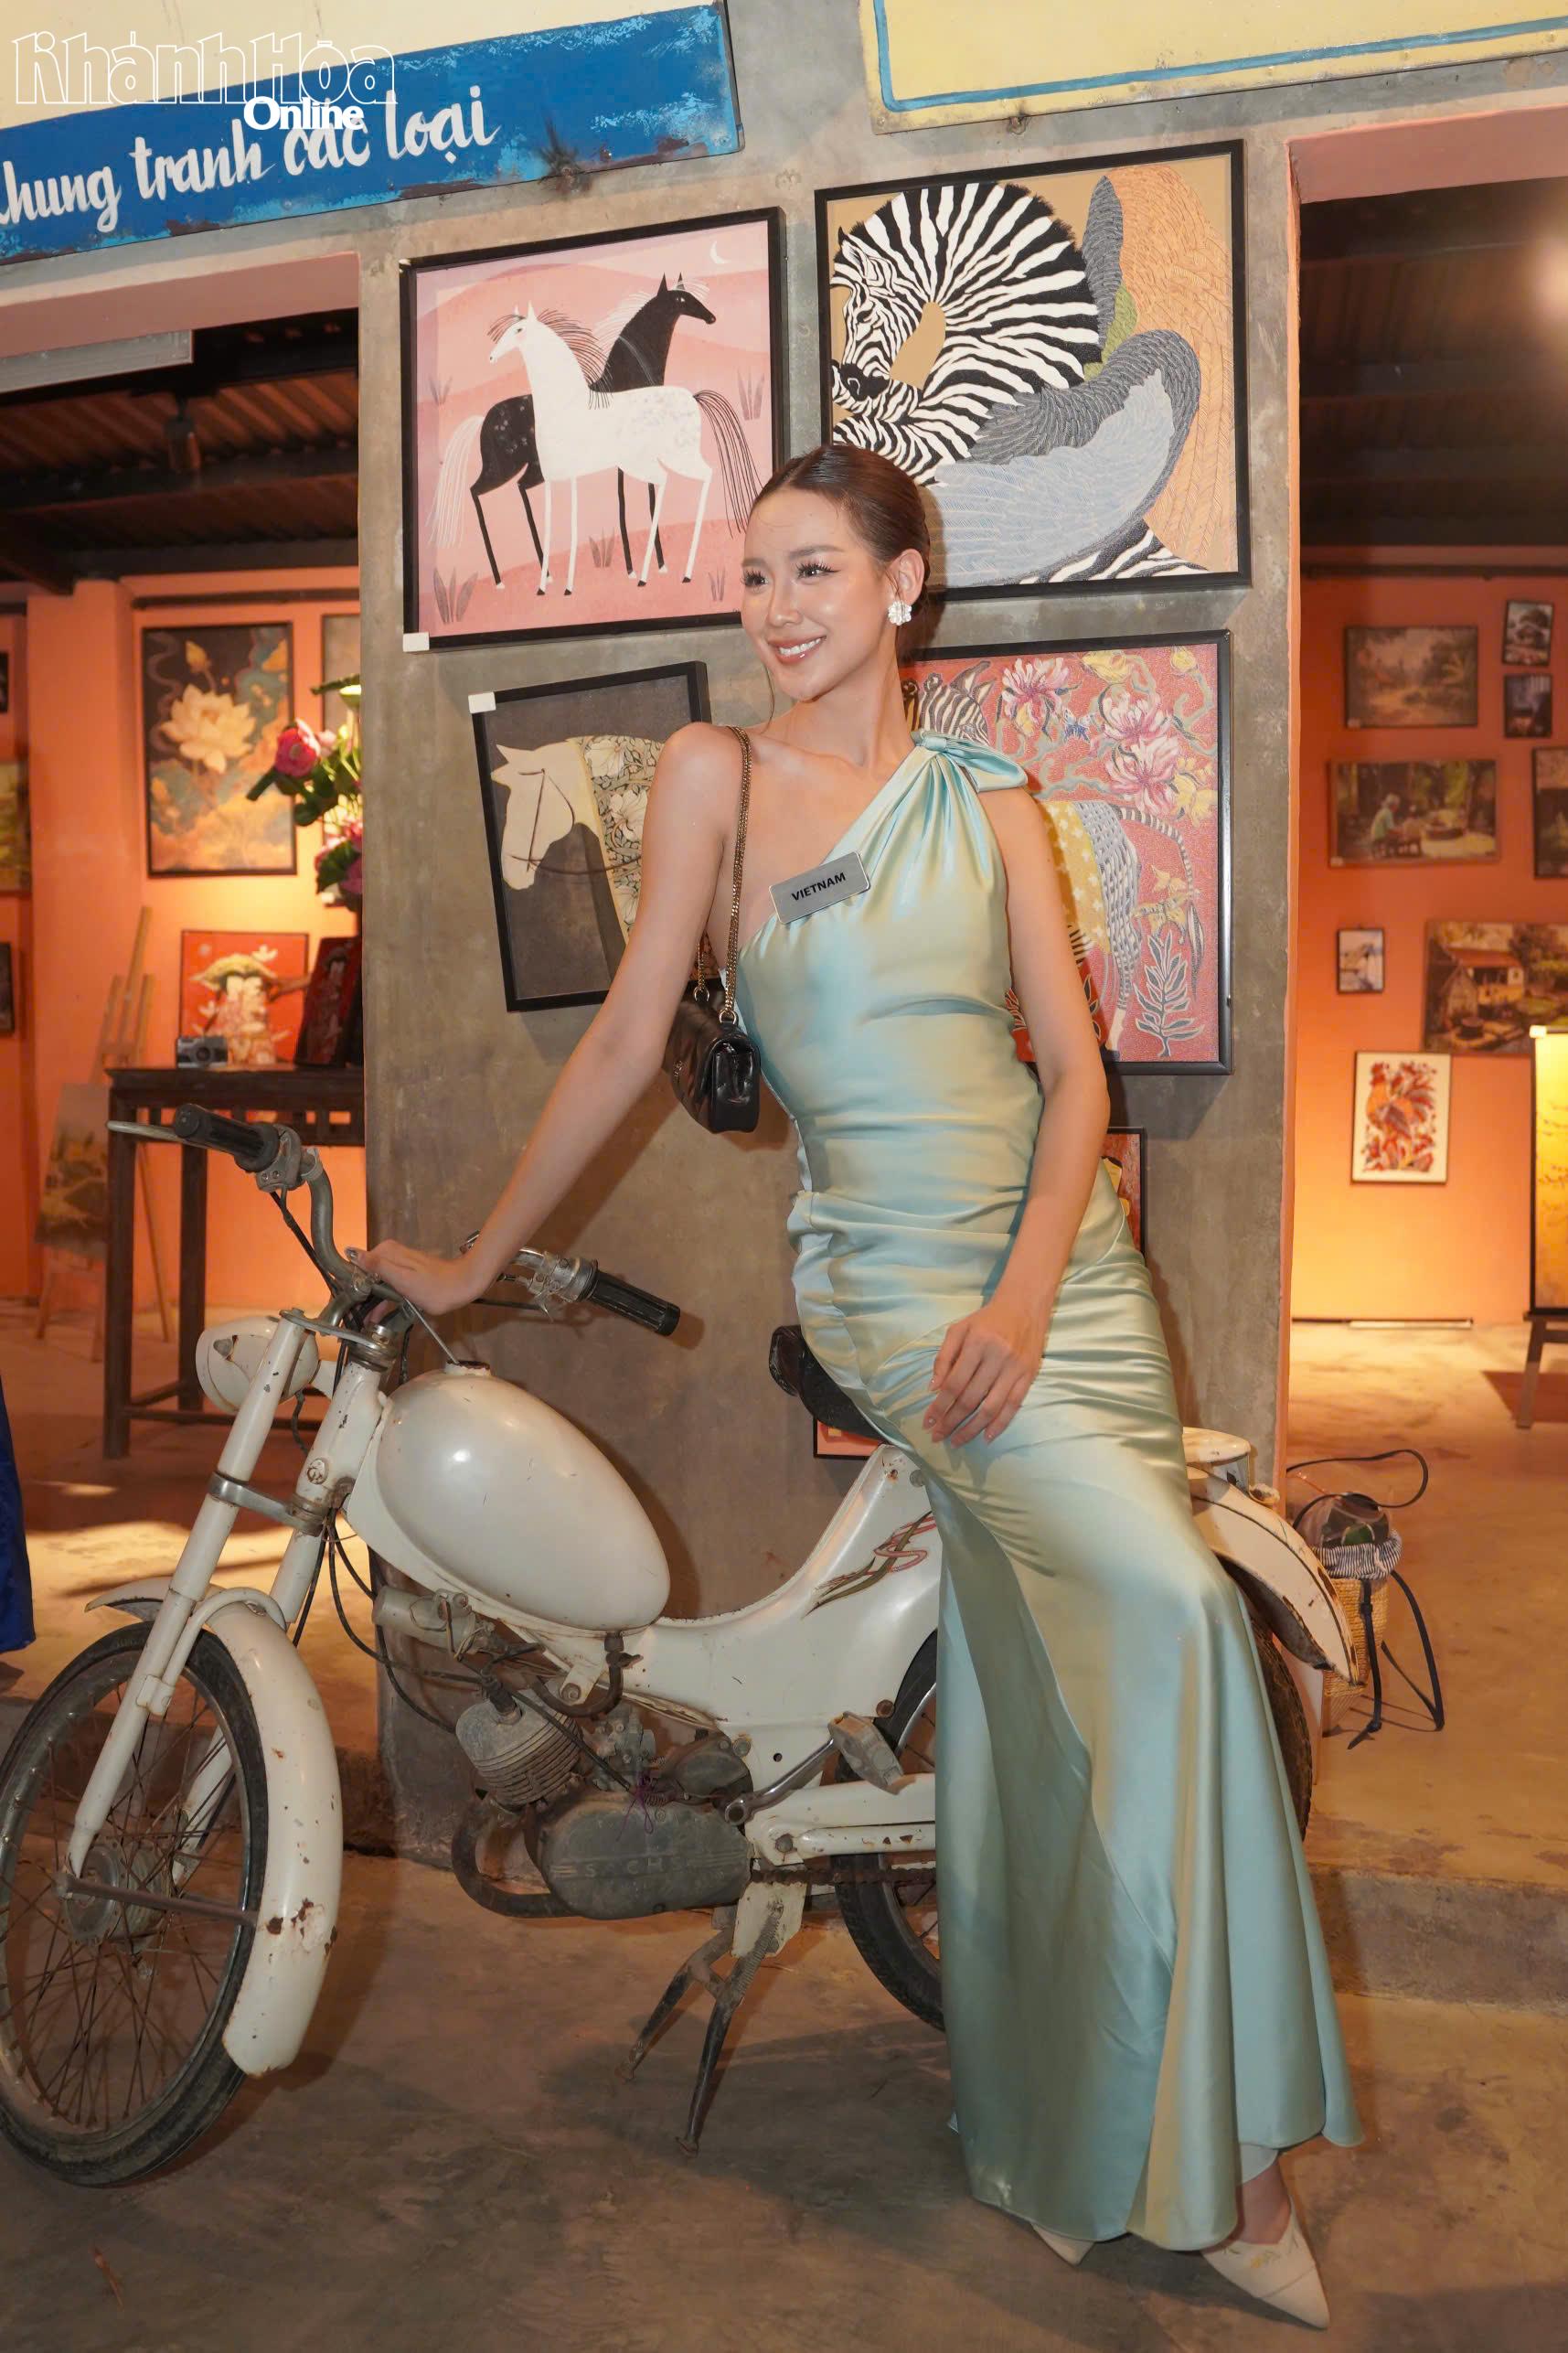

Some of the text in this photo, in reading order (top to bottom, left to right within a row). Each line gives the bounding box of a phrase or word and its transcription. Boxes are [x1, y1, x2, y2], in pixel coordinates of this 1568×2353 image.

[0, 161, 122, 232] hung
[129, 118, 276, 200] tranh
[386, 85, 501, 164] loại
[791, 872, 847, 902] VIETNAM
